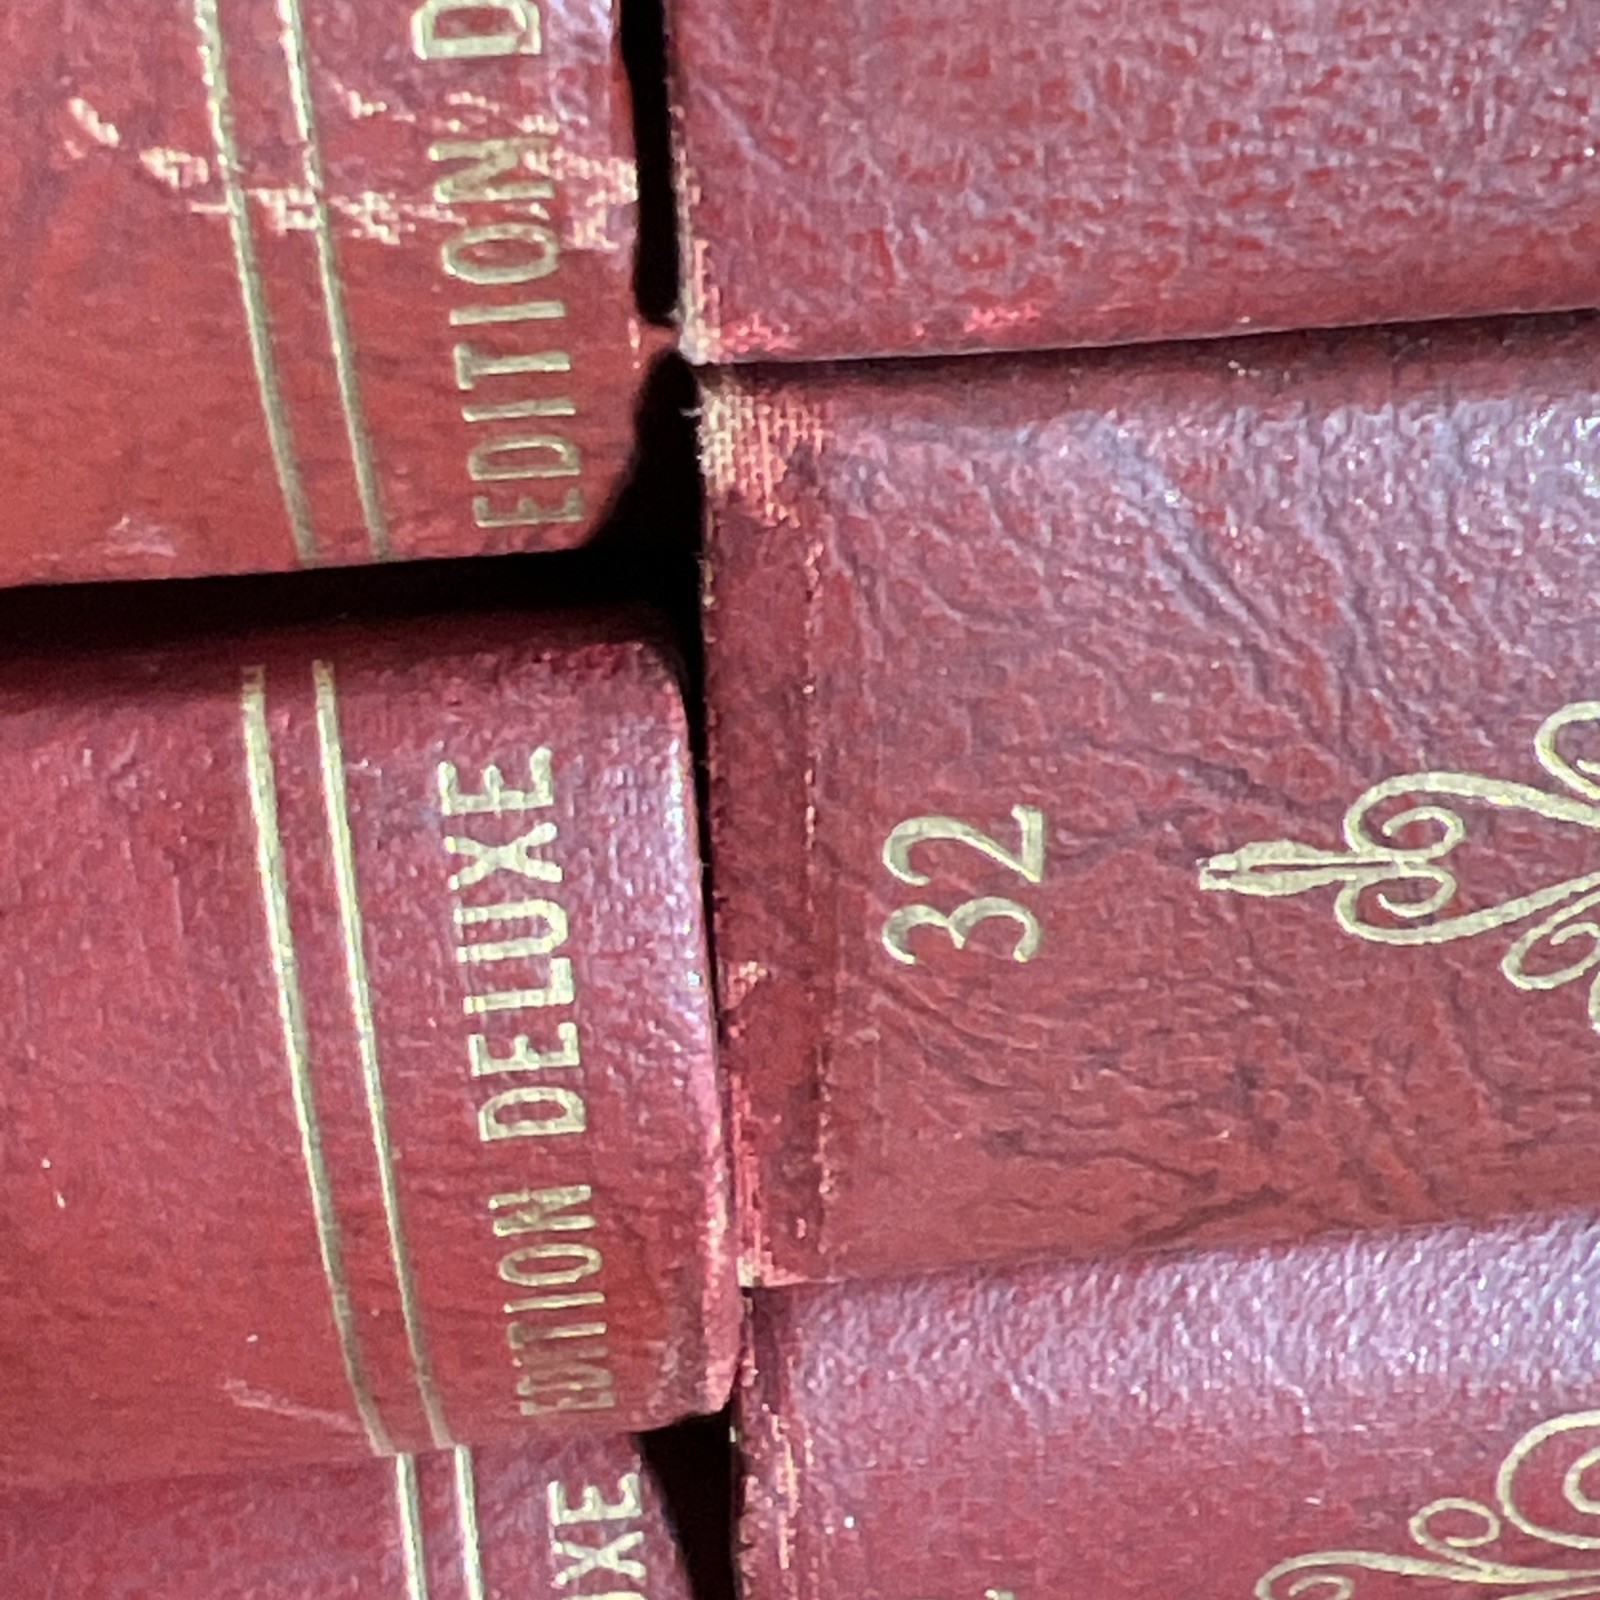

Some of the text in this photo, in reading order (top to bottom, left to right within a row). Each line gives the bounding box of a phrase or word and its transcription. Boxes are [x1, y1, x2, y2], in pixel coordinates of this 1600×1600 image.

[428, 137, 585, 528] EDITION
[882, 804, 1045, 965] 32
[438, 747, 616, 1417] EDITION DELUXE
[548, 1472, 648, 1600] XE
